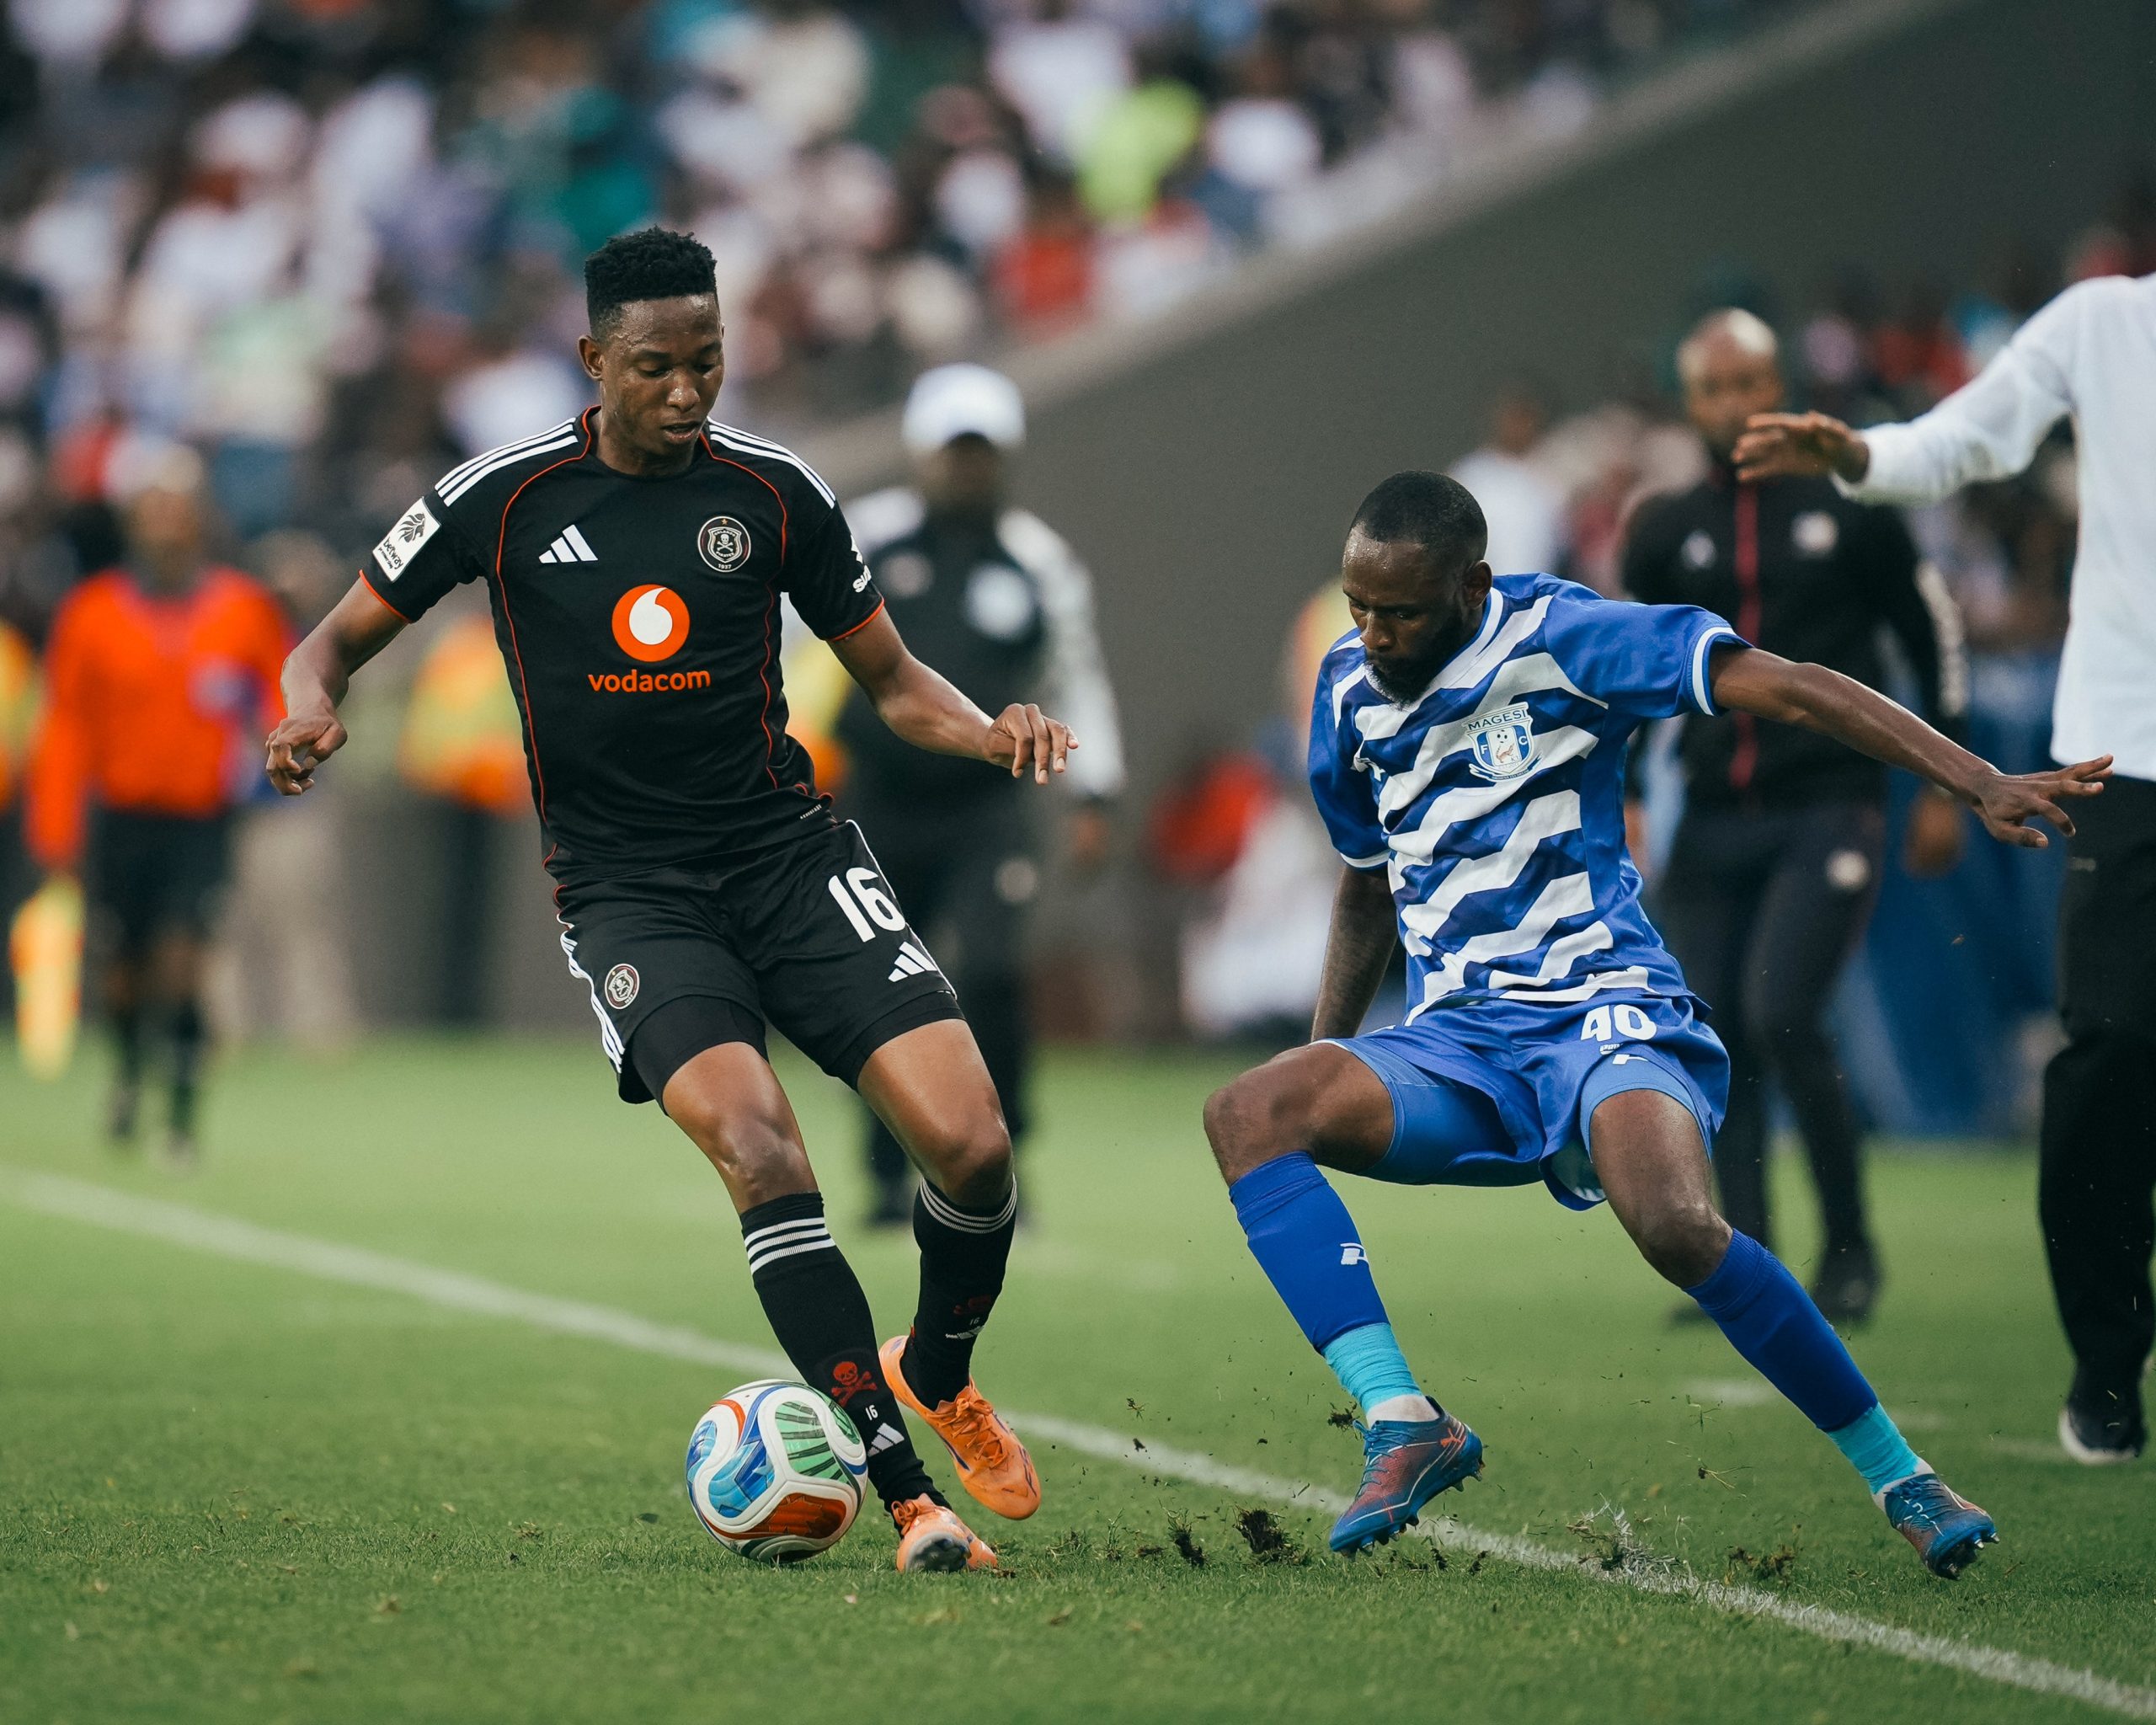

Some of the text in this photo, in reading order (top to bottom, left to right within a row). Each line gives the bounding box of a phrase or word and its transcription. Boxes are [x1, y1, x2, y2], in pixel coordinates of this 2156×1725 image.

[383, 536, 404, 570] betway
[588, 669, 712, 692] vodacom
[1468, 709, 1527, 731] MAGESI
[1480, 735, 1528, 755] F C
[828, 867, 905, 943] 16
[1580, 1003, 1657, 1042] 40
[865, 1404, 878, 1421] 16
